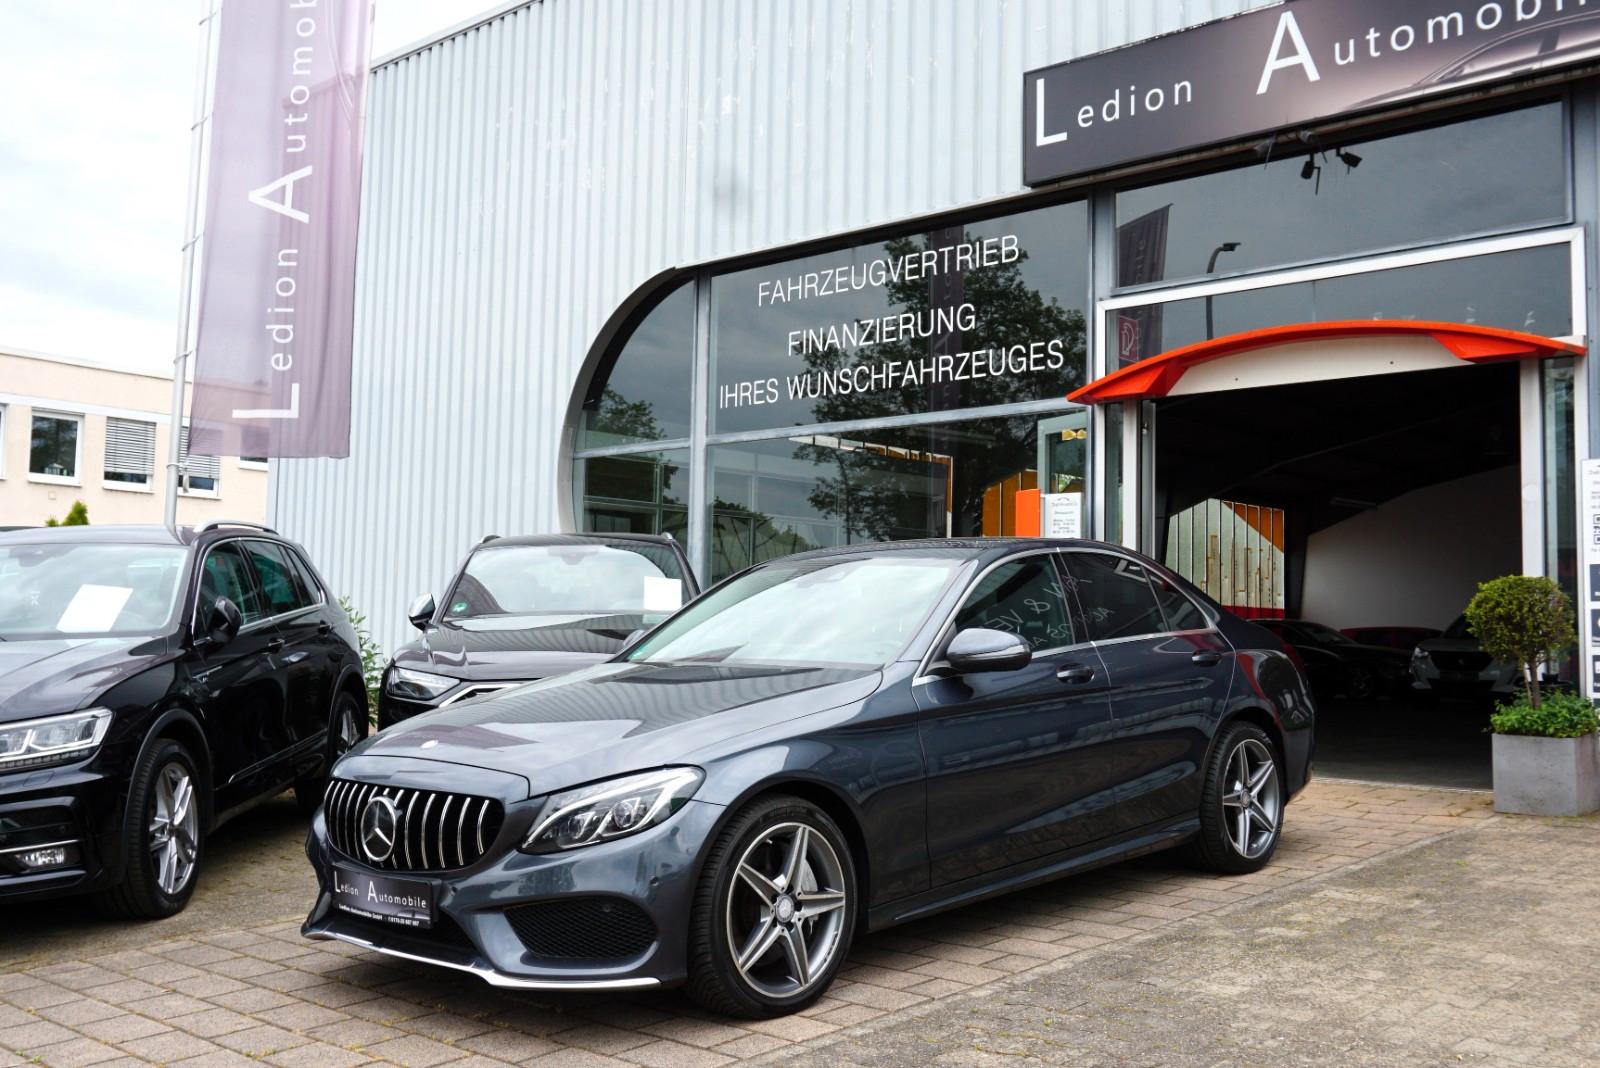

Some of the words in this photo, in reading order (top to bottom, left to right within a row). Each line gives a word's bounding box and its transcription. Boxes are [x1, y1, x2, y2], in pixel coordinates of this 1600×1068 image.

[1036, 78, 1192, 147] Ledion
[1256, 0, 1586, 95] Automob
[757, 234, 1020, 308] FAHRZEUGVERTRIEB
[231, 248, 299, 419] Ledion
[787, 303, 976, 357] FINANZIERUNG
[719, 377, 779, 409] IHRES
[785, 339, 1065, 401] WUNSCHFAHRZEUGES
[334, 870, 359, 896] Ledion
[367, 880, 427, 908] Automobile
